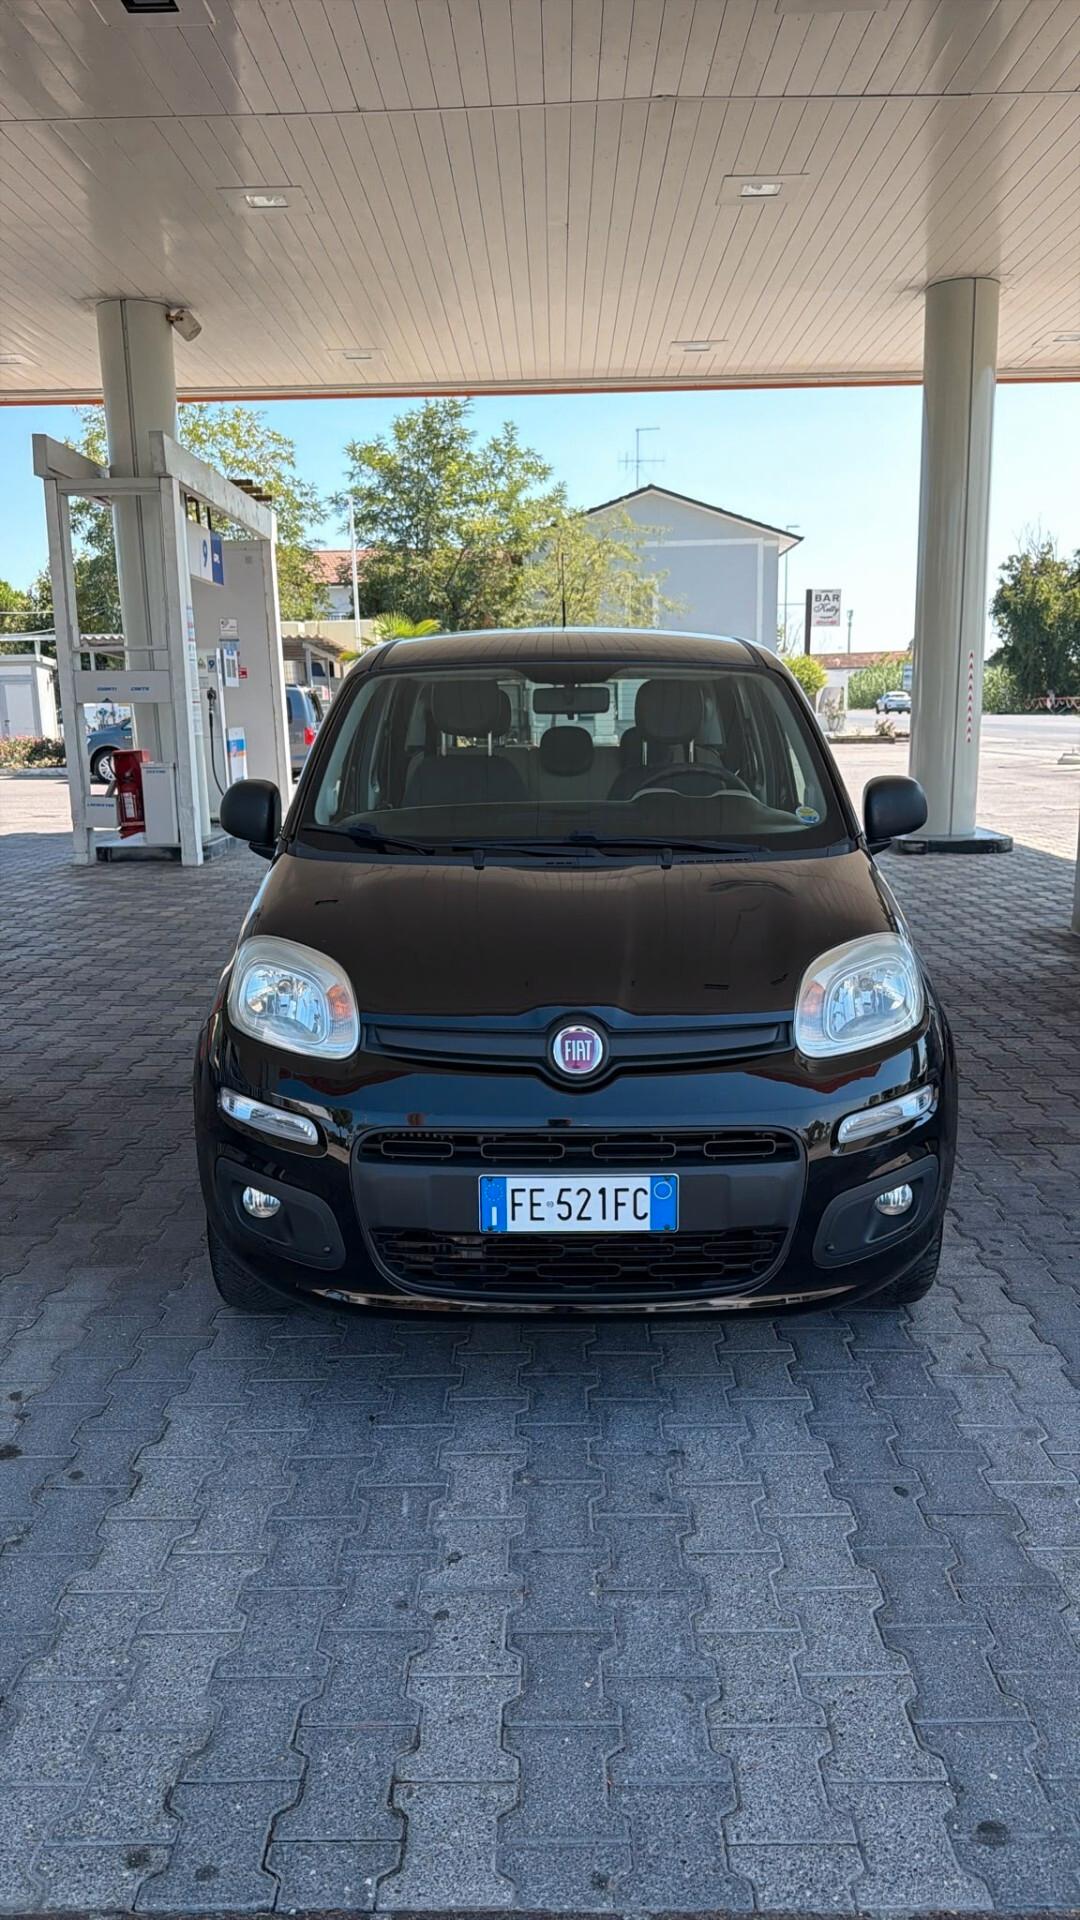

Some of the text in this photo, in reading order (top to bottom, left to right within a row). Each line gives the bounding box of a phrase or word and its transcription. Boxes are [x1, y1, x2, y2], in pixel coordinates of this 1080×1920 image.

[815, 594, 840, 602] BAR
[564, 1039, 593, 1061] FIAT
[511, 1187, 648, 1221] FE 521FC
